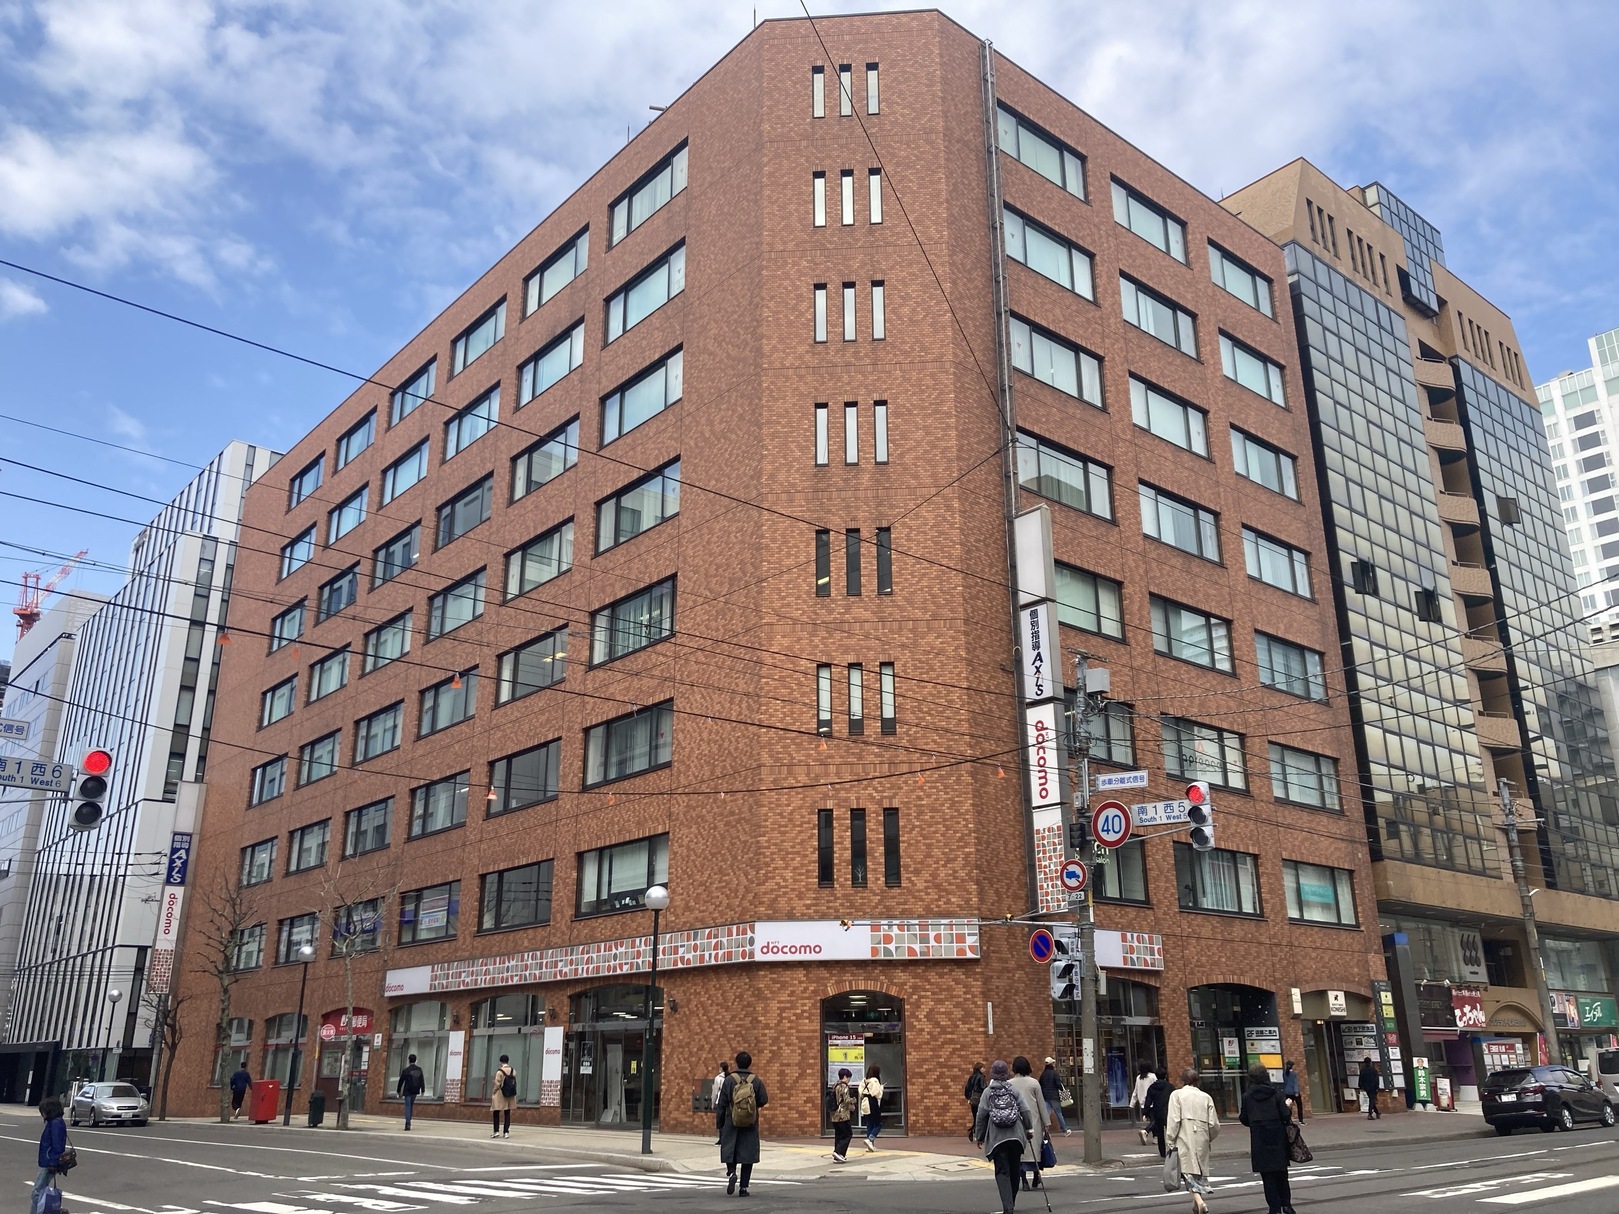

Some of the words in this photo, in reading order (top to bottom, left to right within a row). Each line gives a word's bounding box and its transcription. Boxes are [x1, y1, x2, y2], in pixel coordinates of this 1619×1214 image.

[1030, 608, 1041, 651] 個別指導
[1035, 719, 1049, 800] docomo
[20, 775, 24, 783] 1
[30, 776, 53, 787] West
[55, 779, 62, 788] 6
[1101, 814, 1122, 835] 40
[163, 893, 178, 935] docomo
[760, 941, 822, 955] docomo
[385, 983, 404, 993] docomo
